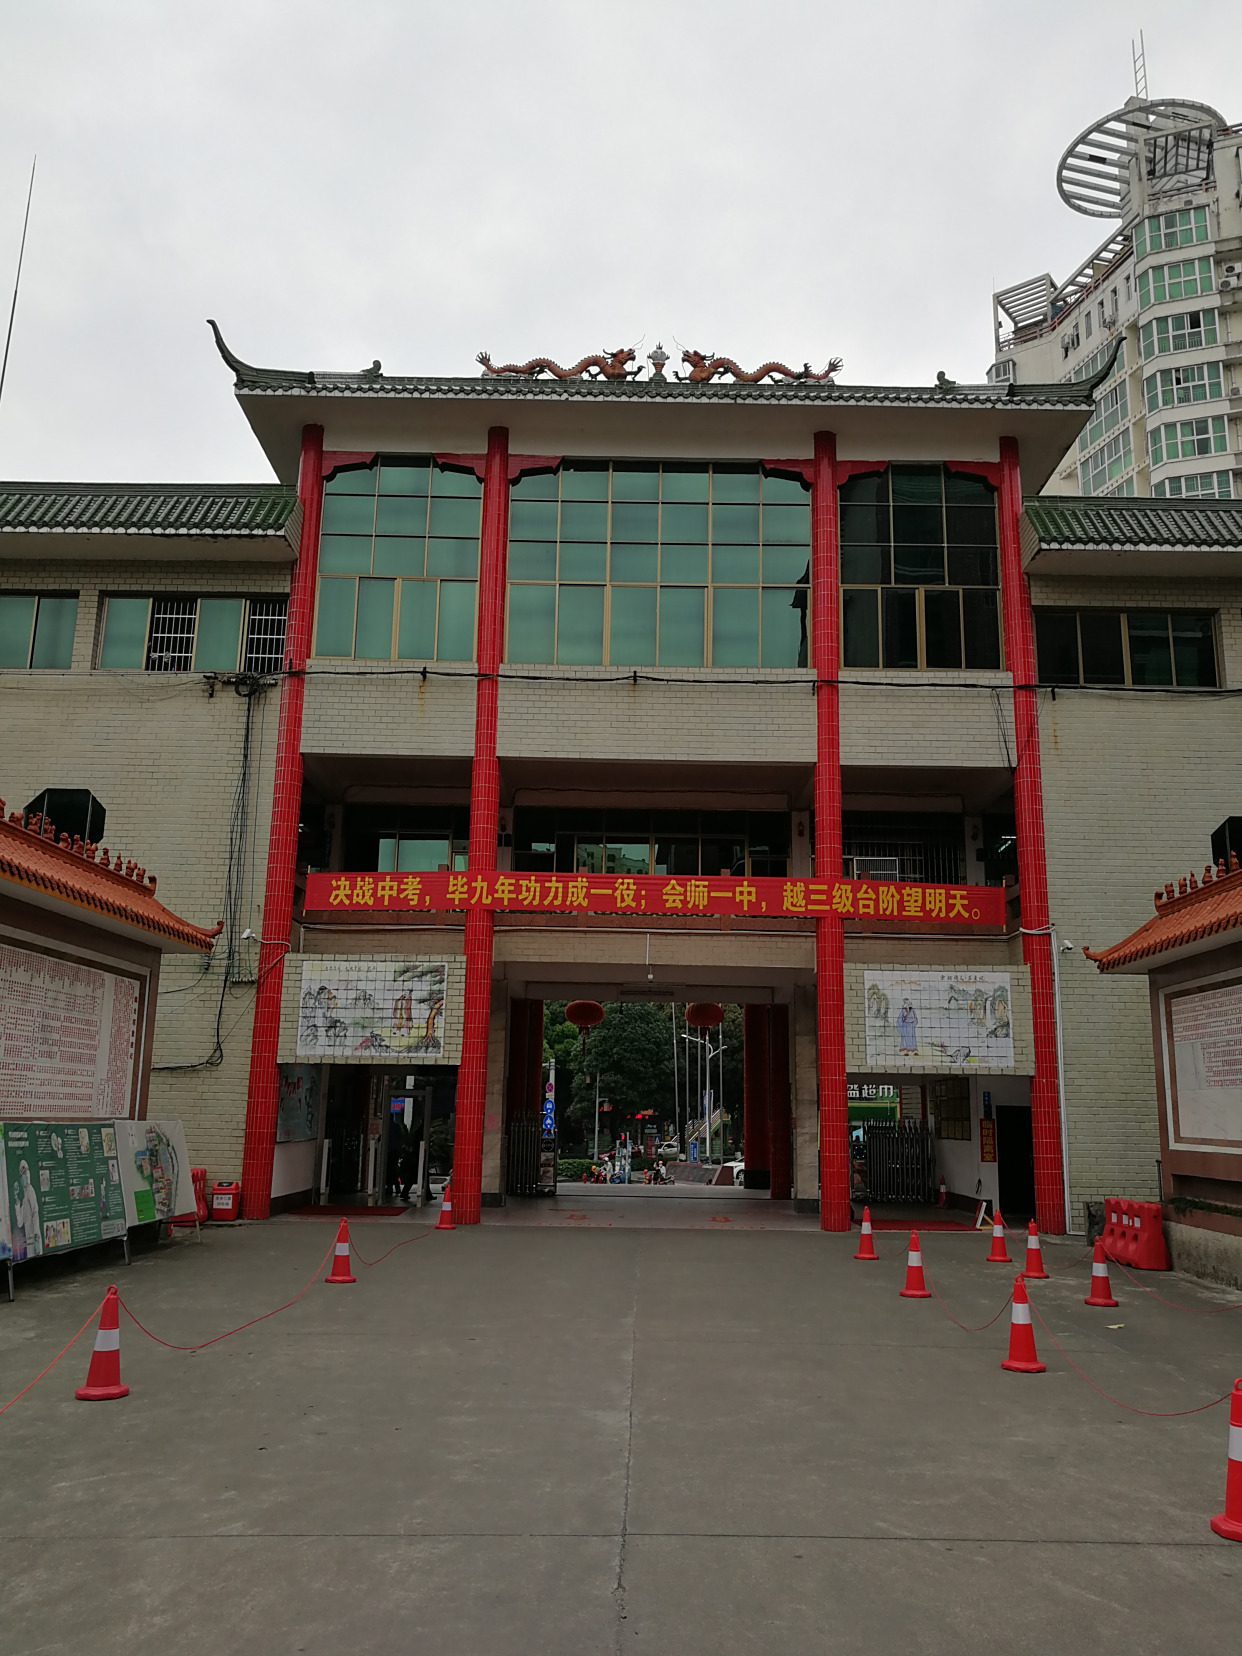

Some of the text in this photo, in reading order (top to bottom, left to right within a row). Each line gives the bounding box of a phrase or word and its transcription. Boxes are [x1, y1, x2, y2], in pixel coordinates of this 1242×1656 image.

[328, 875, 981, 920] 决战中考，毕九年功力成一役；会师一中，越三级台阶望明天。
